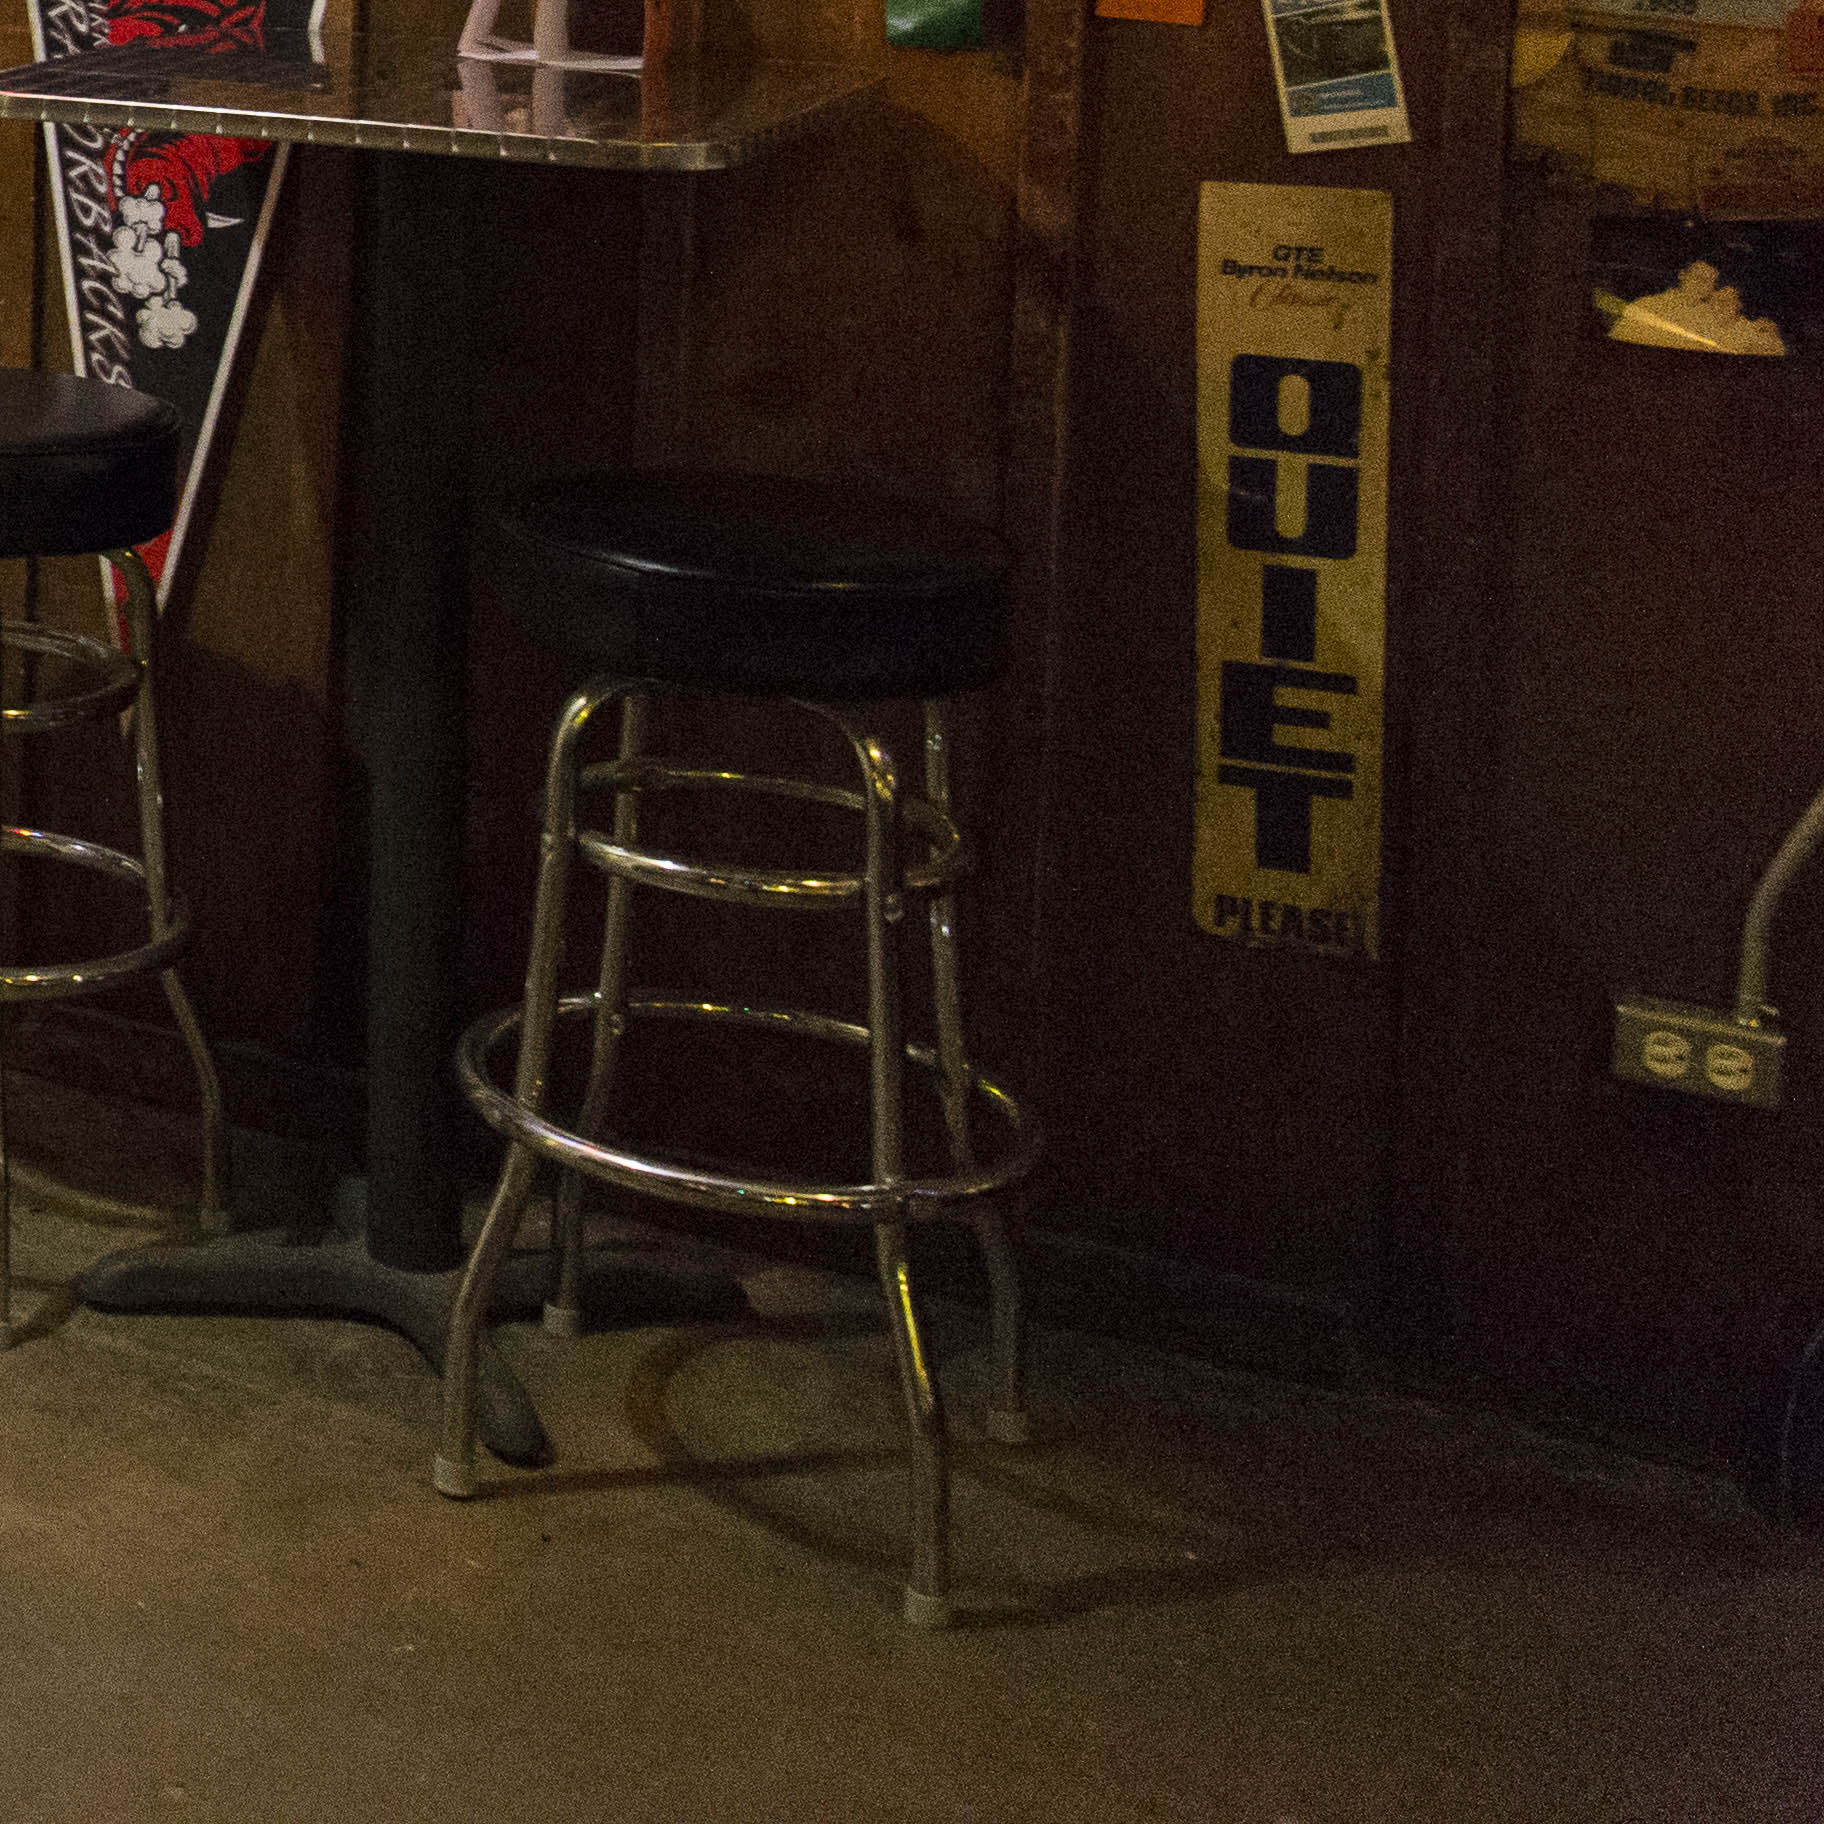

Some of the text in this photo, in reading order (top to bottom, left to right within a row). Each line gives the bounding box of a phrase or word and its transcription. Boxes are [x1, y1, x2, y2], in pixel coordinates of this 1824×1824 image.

[1272, 245, 1324, 265] GTE
[1221, 256, 1379, 286] Byron Nelson
